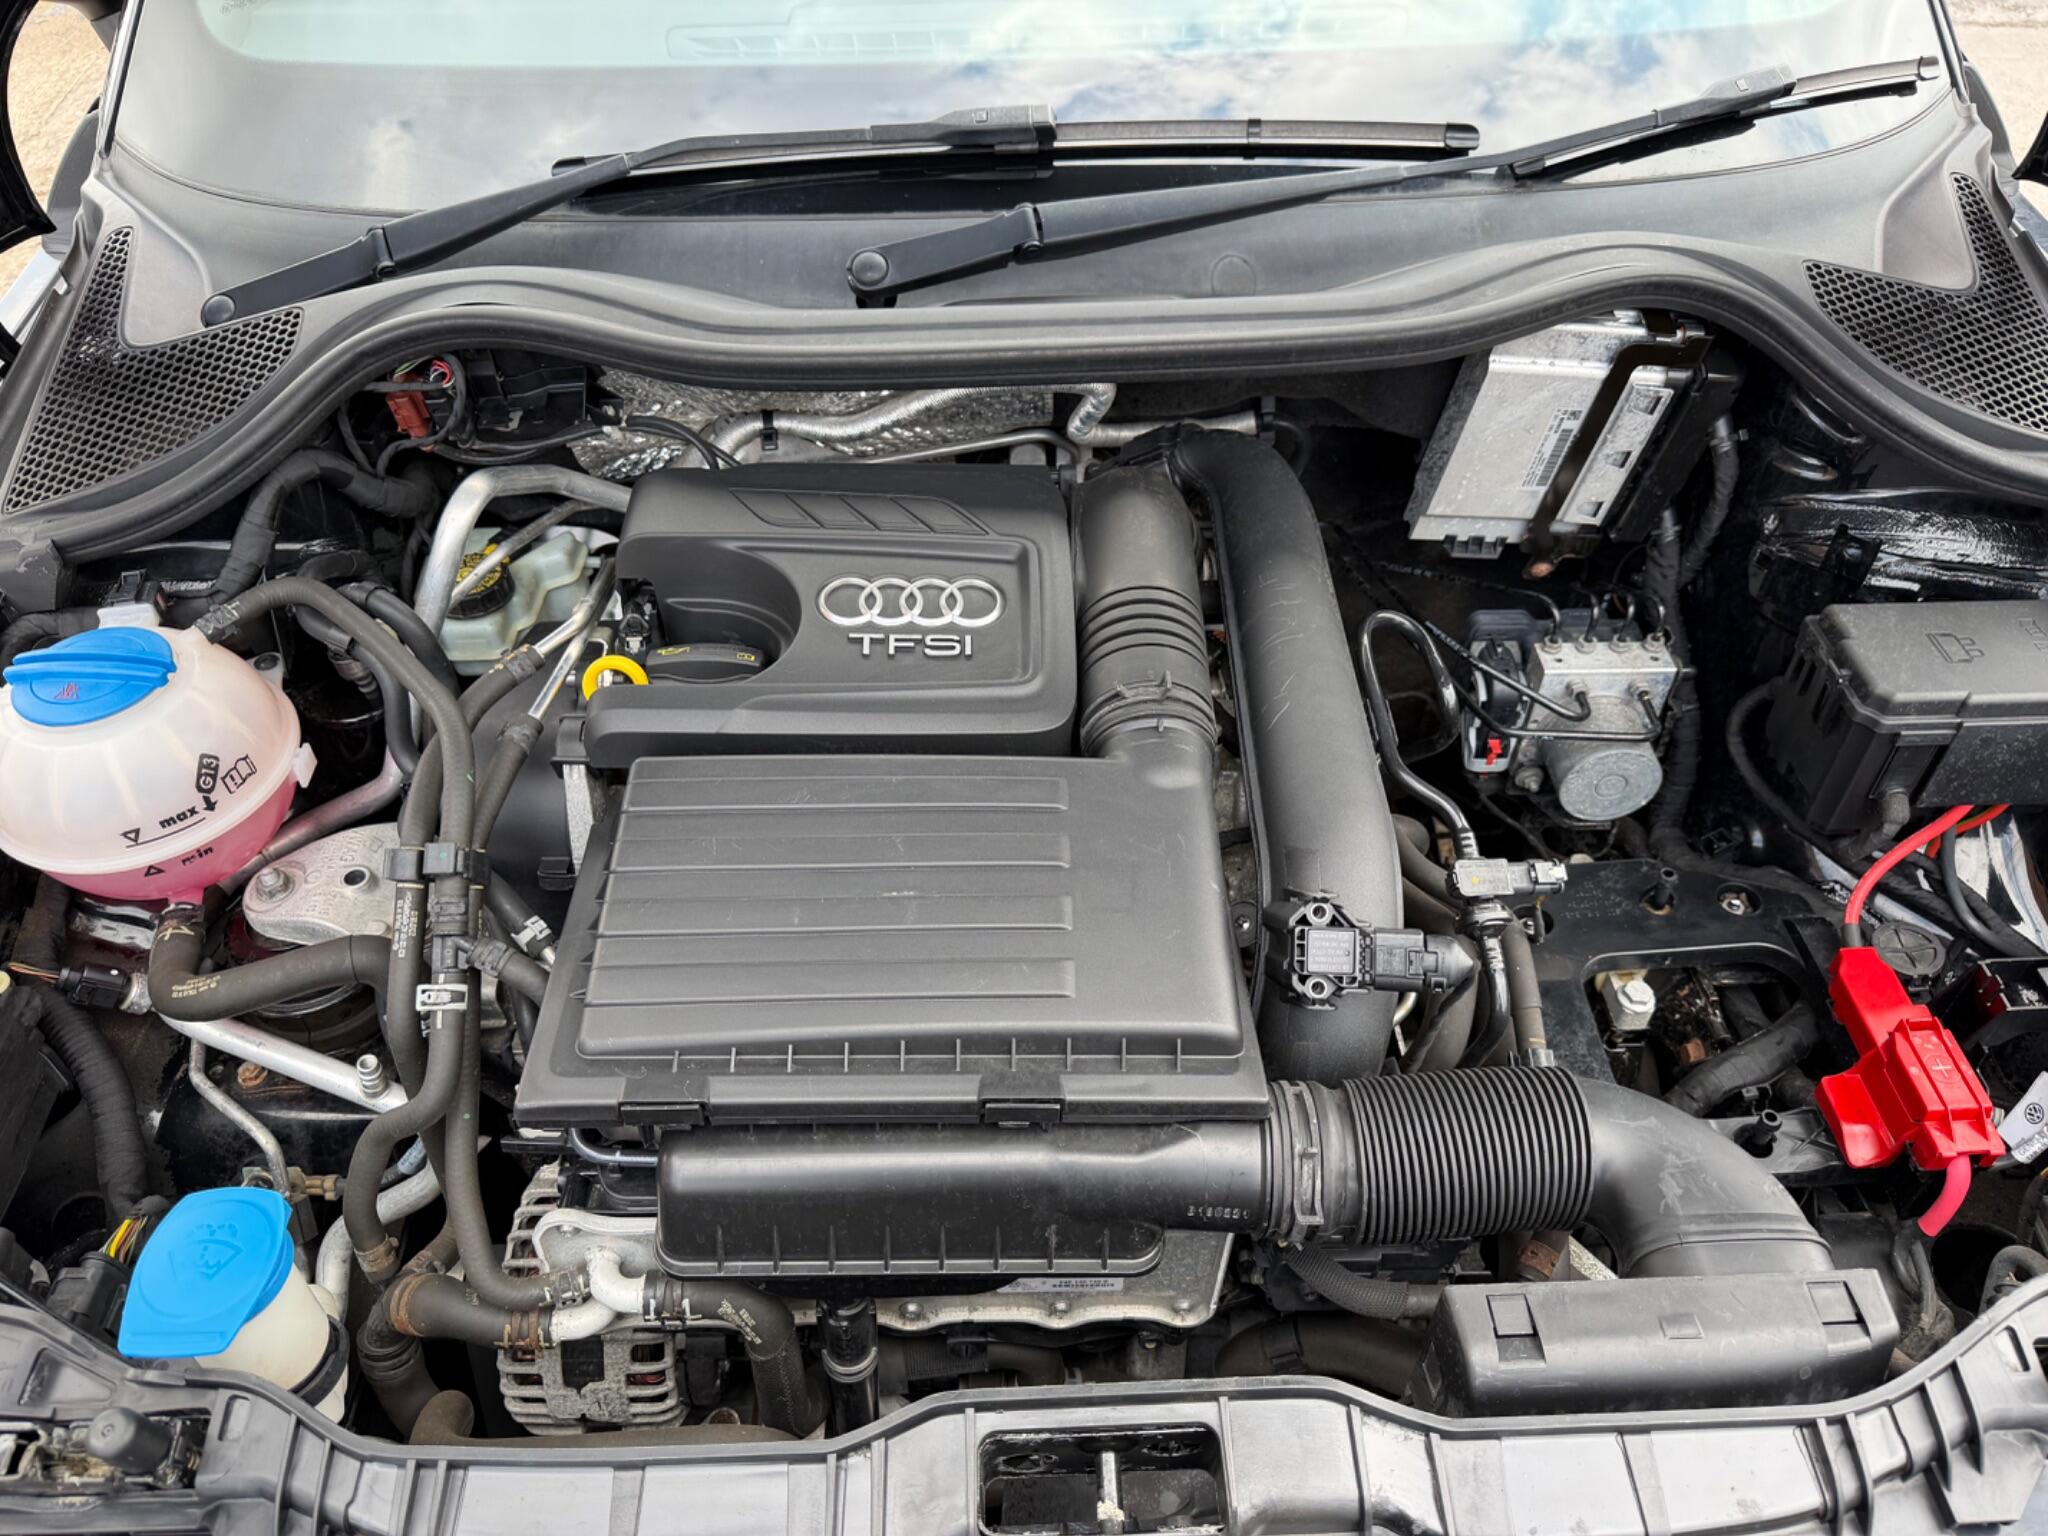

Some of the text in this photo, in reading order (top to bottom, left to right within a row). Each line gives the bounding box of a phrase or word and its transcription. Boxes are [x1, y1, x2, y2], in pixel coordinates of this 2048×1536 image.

[848, 632, 973, 657] TFSI
[199, 756, 219, 791] G13
[158, 805, 199, 830] max
